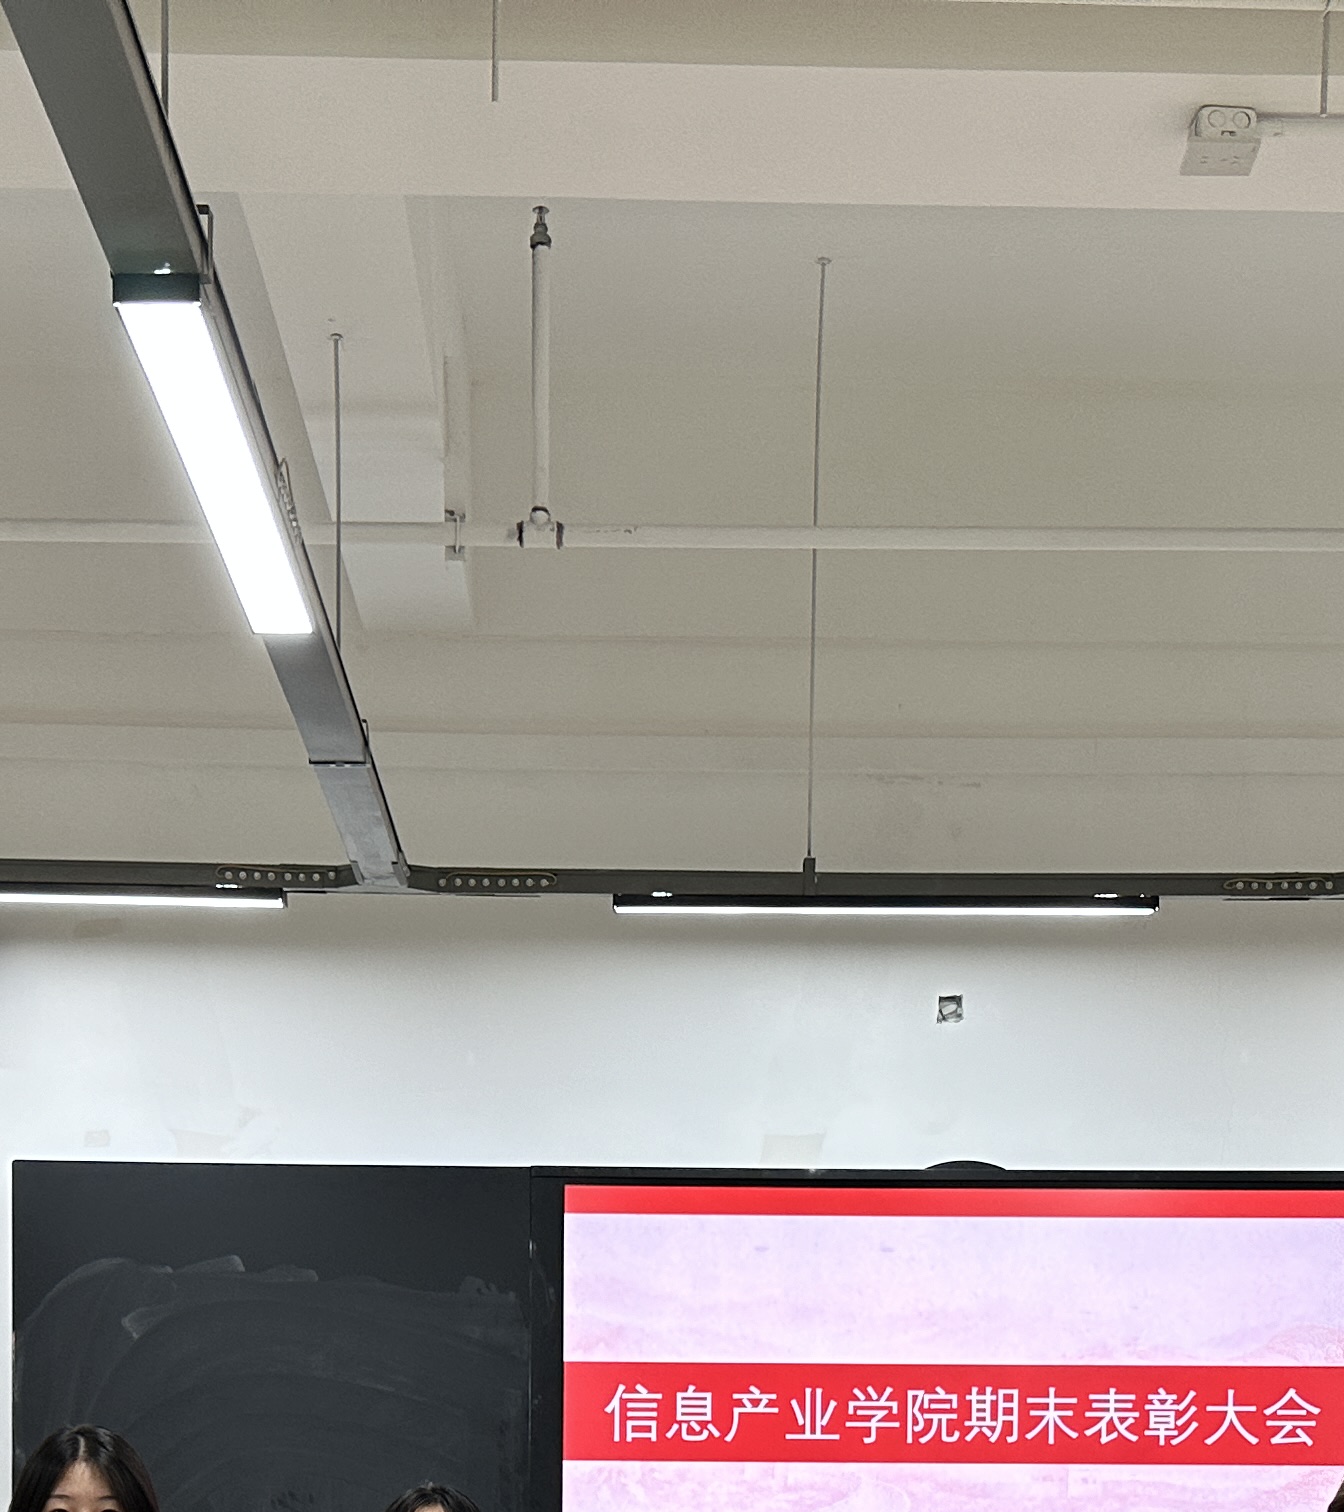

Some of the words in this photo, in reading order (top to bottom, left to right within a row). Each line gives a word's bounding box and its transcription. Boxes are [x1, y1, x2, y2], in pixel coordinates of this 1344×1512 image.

[605, 1384, 1322, 1447] 信息产业学院期末表彰大会
